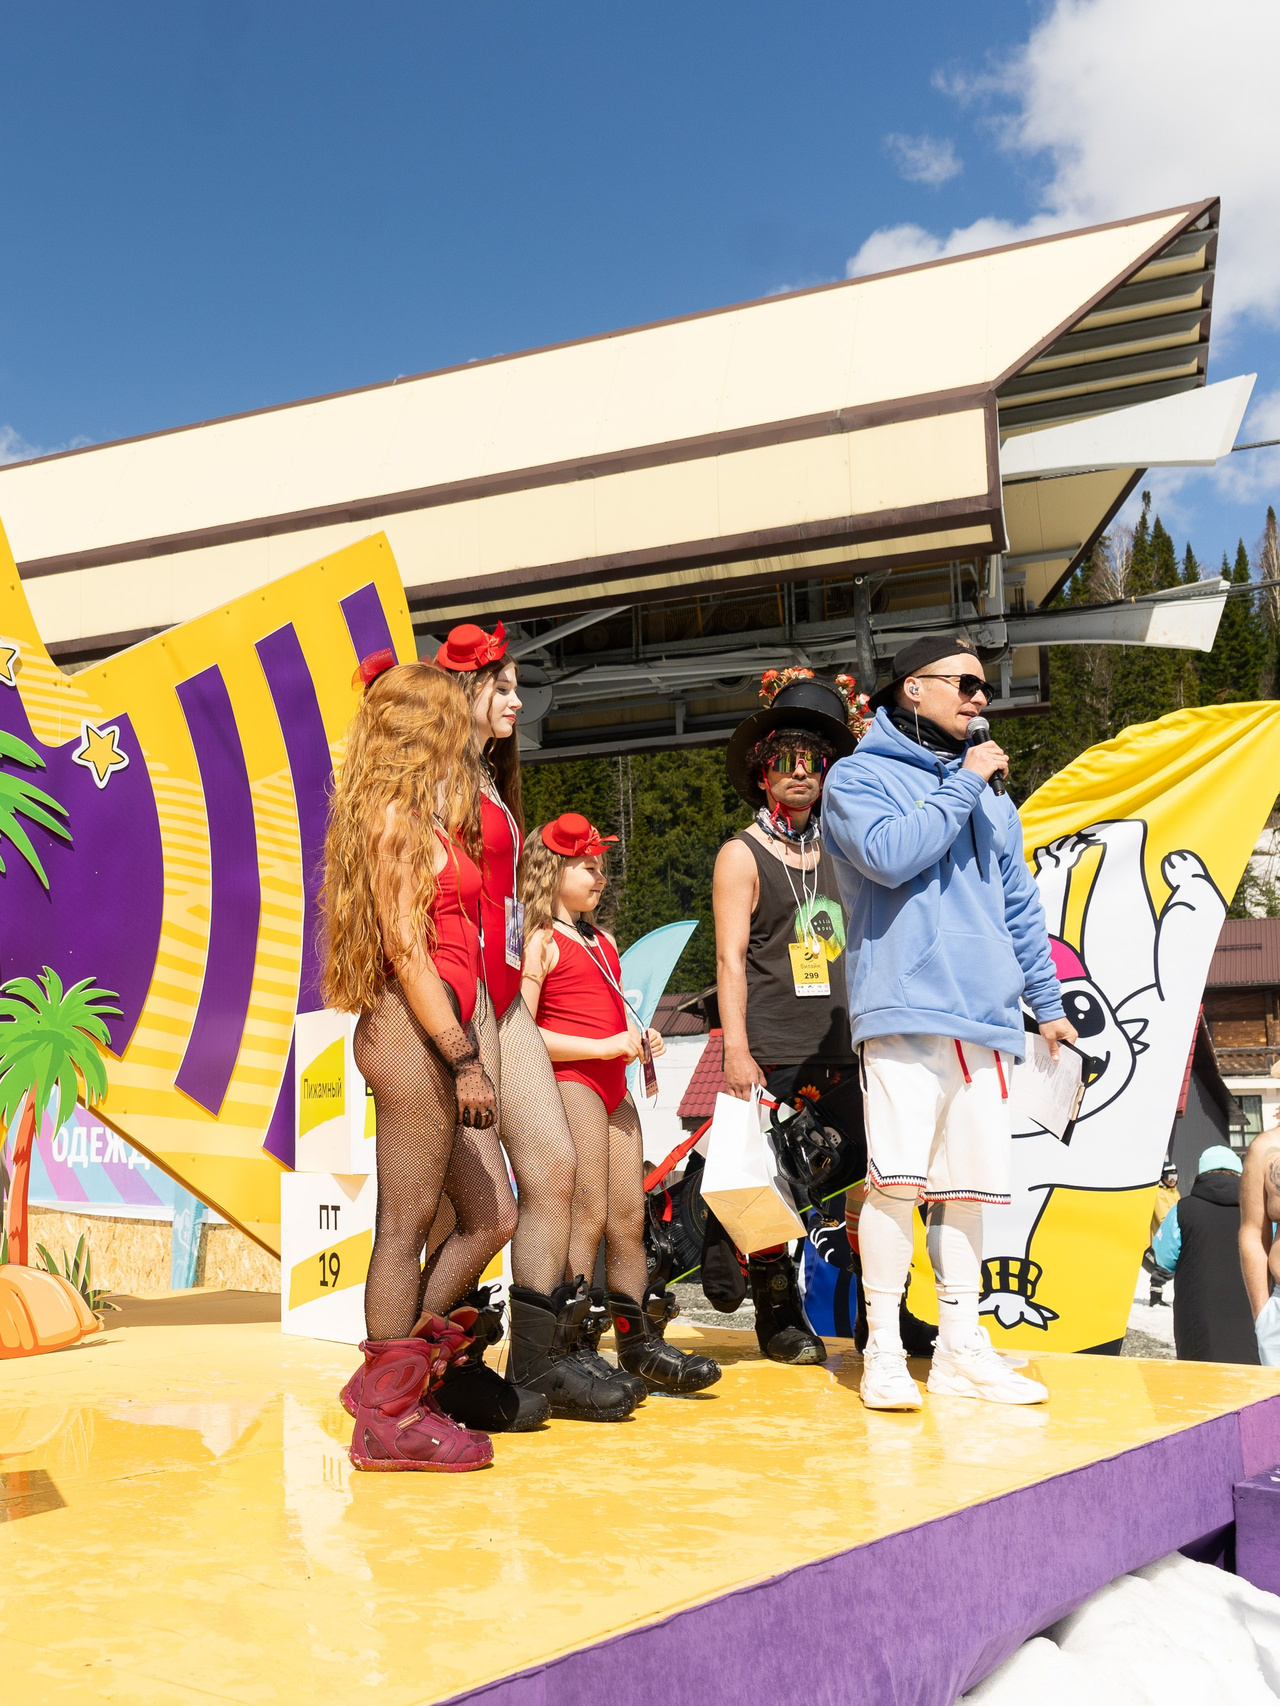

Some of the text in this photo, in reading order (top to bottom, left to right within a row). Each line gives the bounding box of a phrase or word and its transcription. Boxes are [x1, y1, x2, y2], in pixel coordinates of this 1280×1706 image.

[303, 1077, 342, 1100] Пижамный
[319, 1204, 341, 1231] ПТ
[318, 1251, 341, 1288] 19
